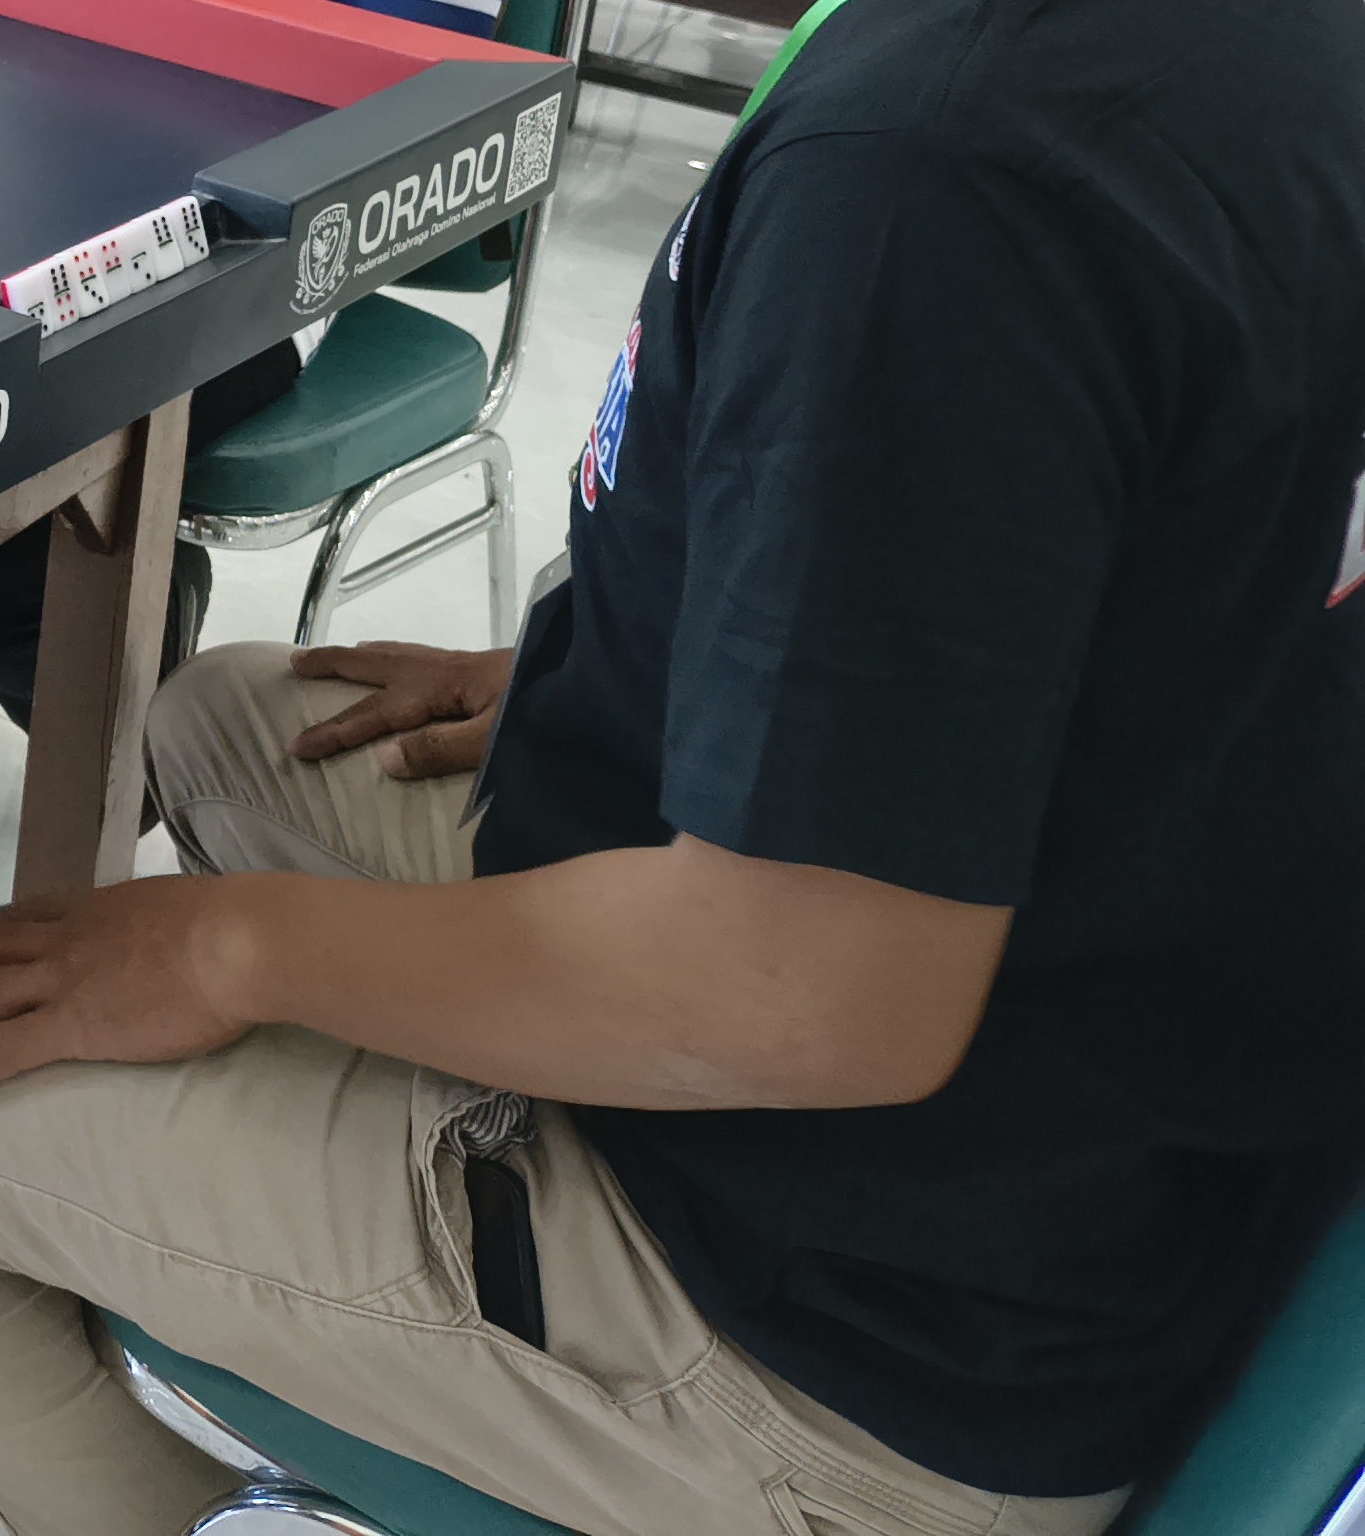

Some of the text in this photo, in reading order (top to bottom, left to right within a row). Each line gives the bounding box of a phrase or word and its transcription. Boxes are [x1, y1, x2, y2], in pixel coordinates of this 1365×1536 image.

[312, 209, 345, 235] ORADO
[353, 192, 497, 278] Federasi Olahraga Domino Nasional
[358, 132, 505, 254] ORADO
